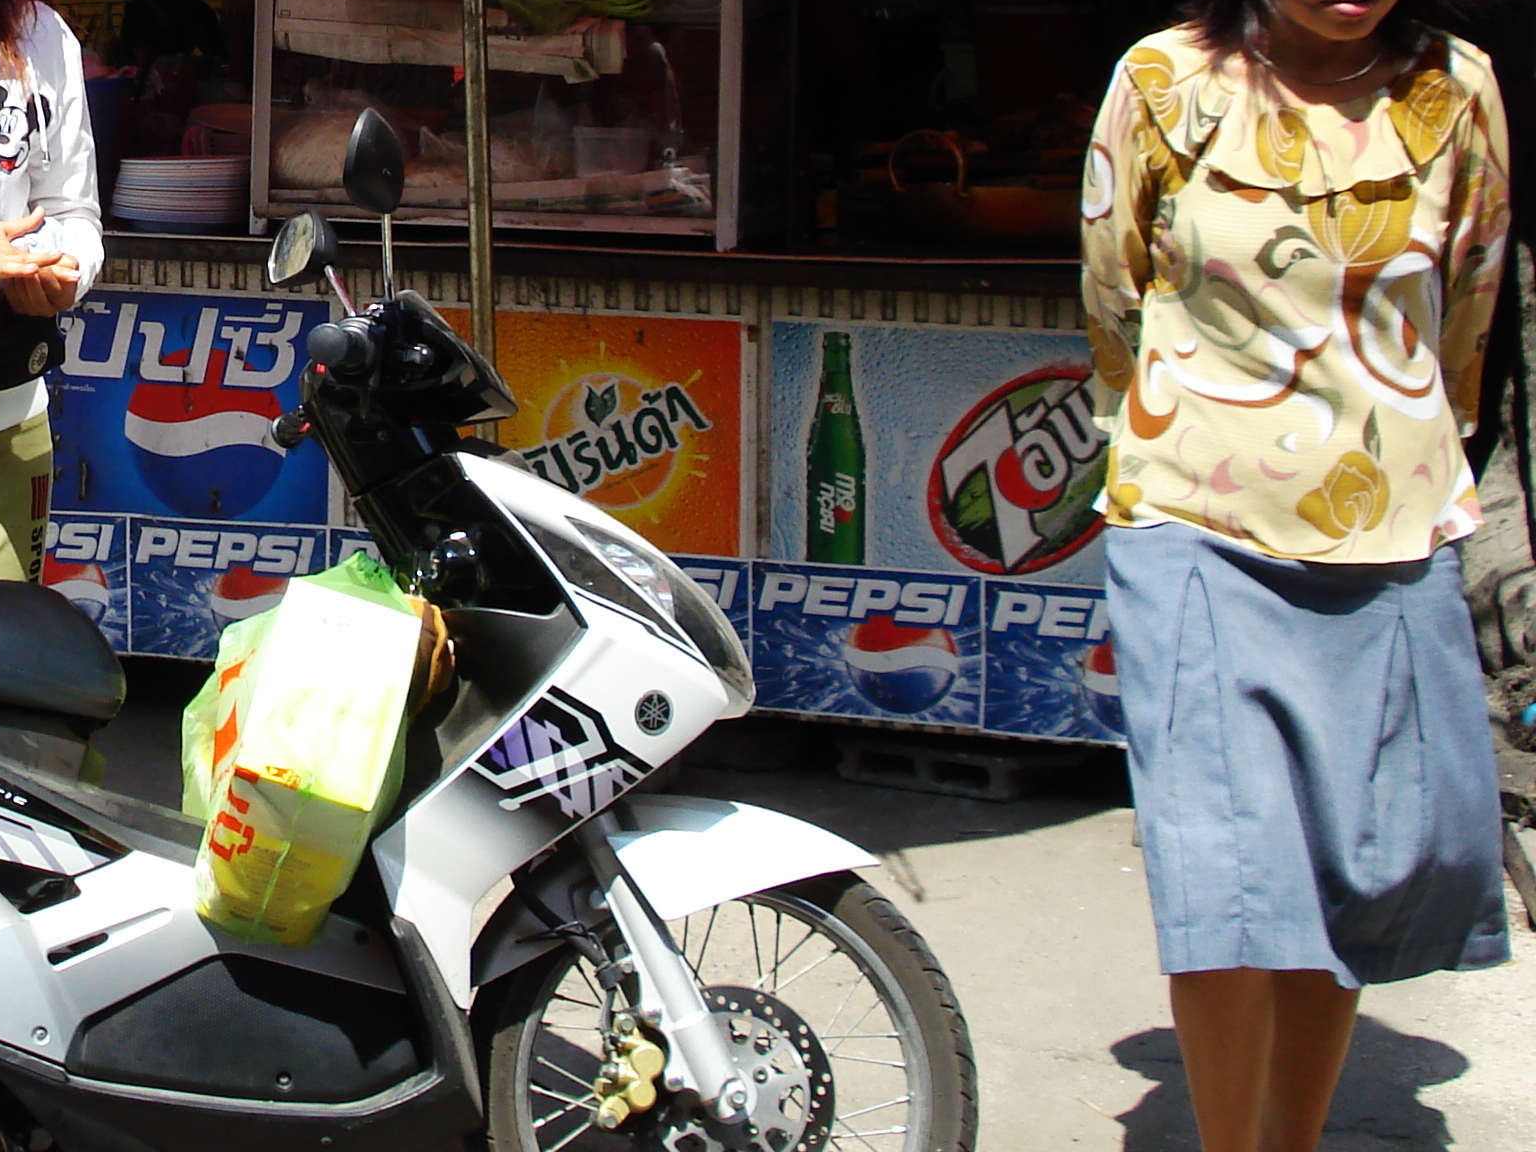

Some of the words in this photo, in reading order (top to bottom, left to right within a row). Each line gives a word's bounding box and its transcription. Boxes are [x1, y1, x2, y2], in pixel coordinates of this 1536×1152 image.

[58, 301, 305, 389] ป๊ปซี่
[134, 526, 316, 575] PEPSI
[758, 572, 969, 626] PEPSI
[991, 589, 1111, 641] PEP
